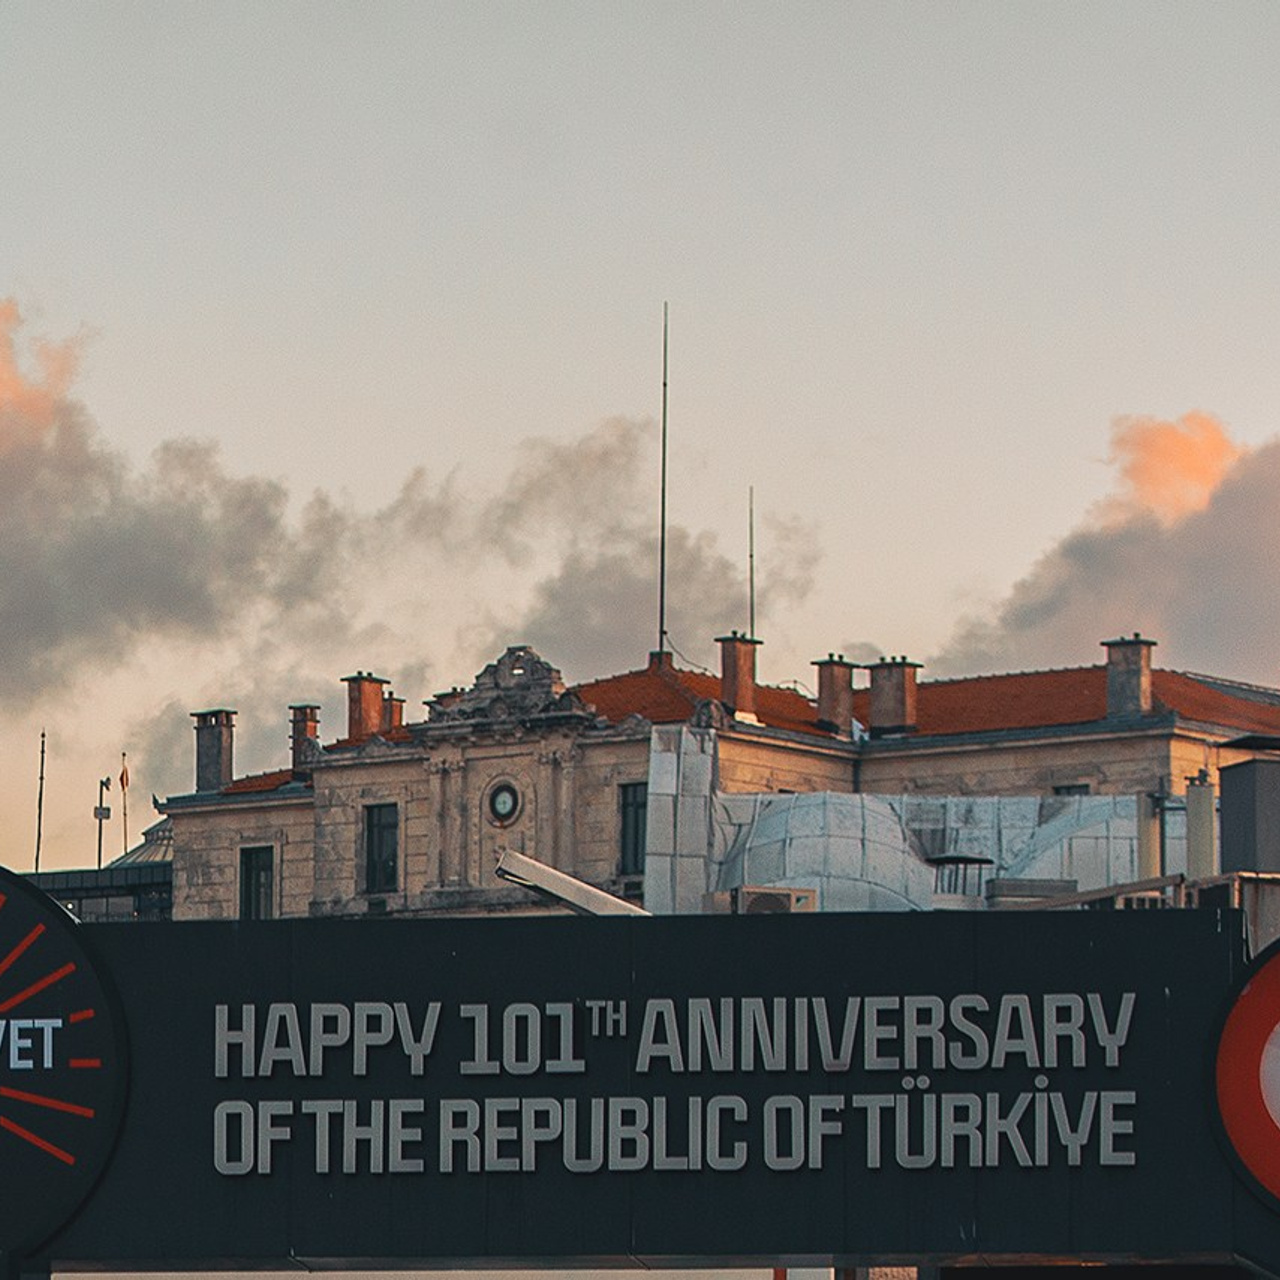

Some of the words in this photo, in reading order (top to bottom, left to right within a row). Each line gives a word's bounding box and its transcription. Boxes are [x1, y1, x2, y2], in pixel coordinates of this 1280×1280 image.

[214, 1001, 442, 1077] HAPPY
[635, 992, 1136, 1072] ANNIVERSARY
[213, 1100, 294, 1175] OF
[301, 1099, 425, 1174] THE
[439, 1095, 748, 1173] REPUBLIC
[763, 1095, 845, 1170] OF
[852, 1074, 1136, 1169] TÜRKİYE
